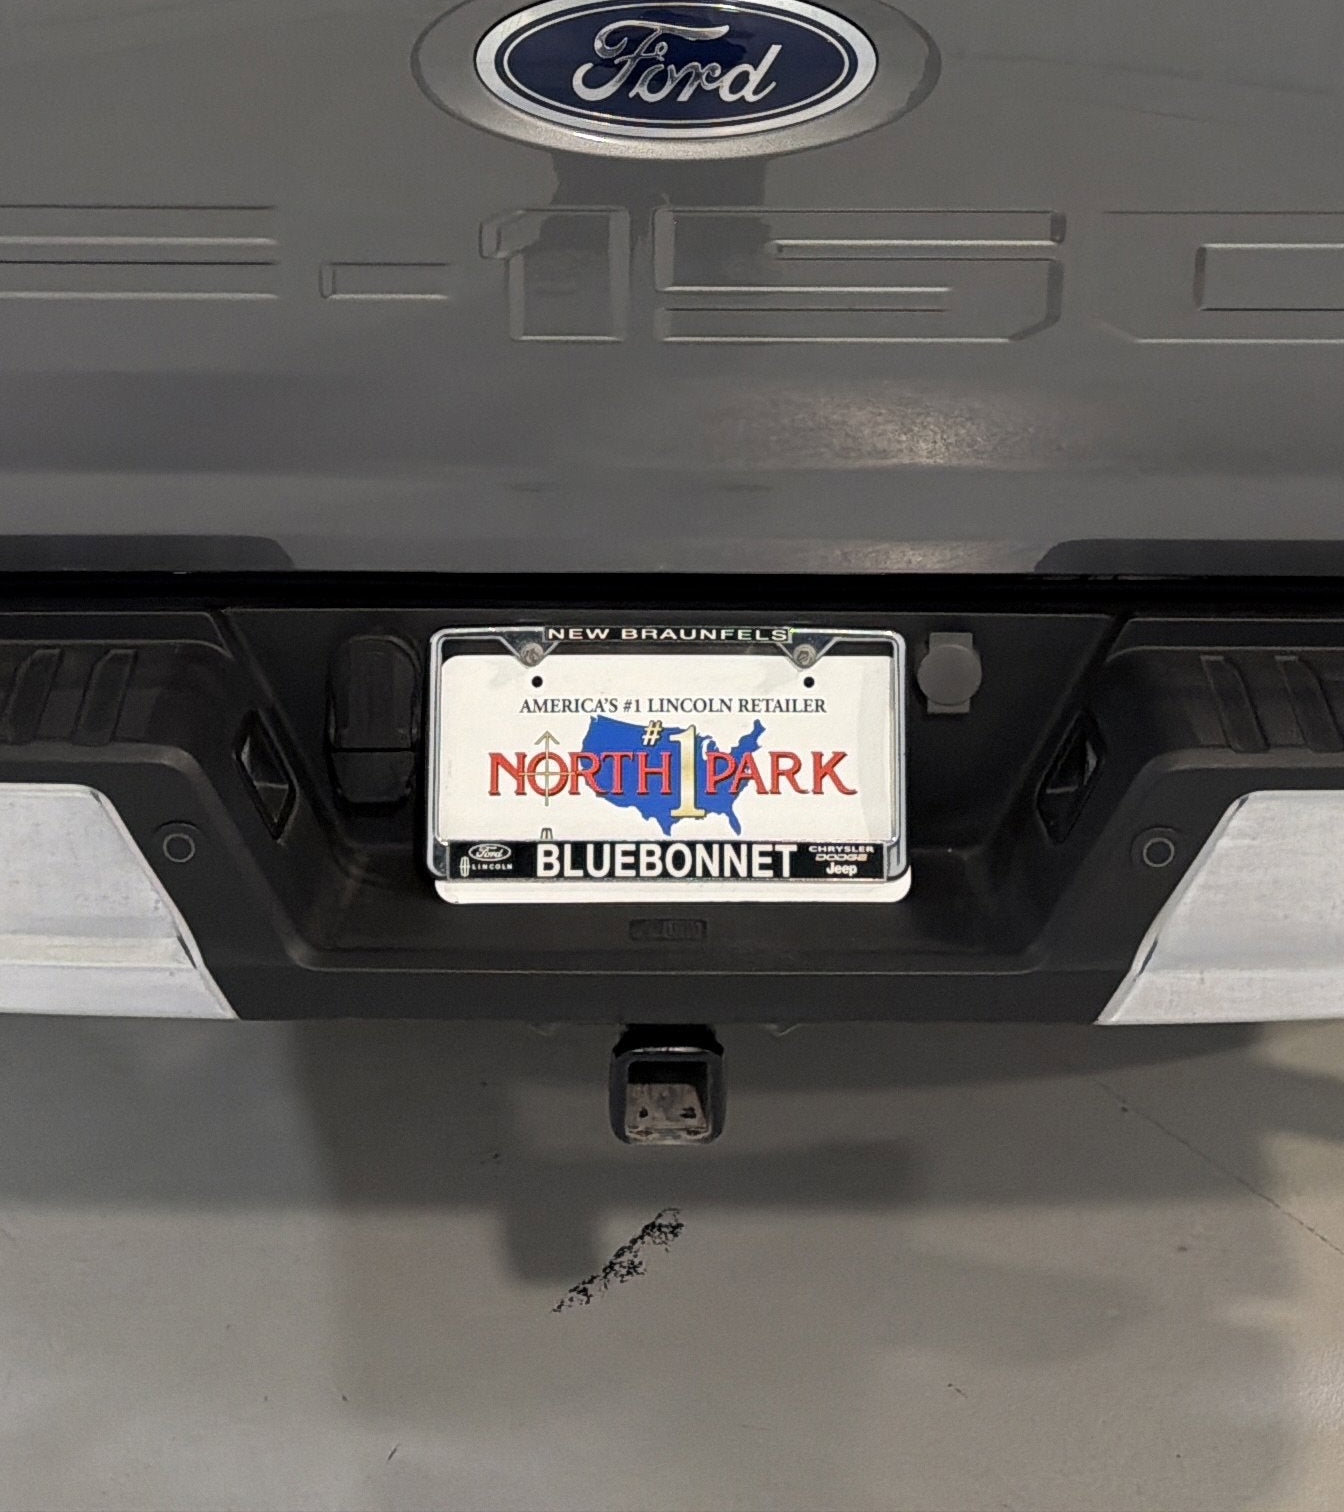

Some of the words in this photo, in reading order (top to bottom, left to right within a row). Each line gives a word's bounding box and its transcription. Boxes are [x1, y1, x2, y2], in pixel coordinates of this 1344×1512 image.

[571, 19, 777, 103] Ford
[548, 628, 609, 640] NEW
[621, 628, 788, 641] BRAUNFELS
[519, 698, 618, 714] AMERICA'S
[623, 698, 641, 713] #1
[648, 698, 733, 713] LINCOLN
[738, 698, 828, 713] RETAILER
[488, 751, 671, 797] NORTH
[705, 751, 859, 796] PARK
[476, 846, 504, 858] Ford
[808, 845, 875, 853] CHRYSLER
[537, 843, 798, 879] BLUEBONNET
[815, 853, 869, 862] DODGE
[826, 862, 859, 876] Jeep
